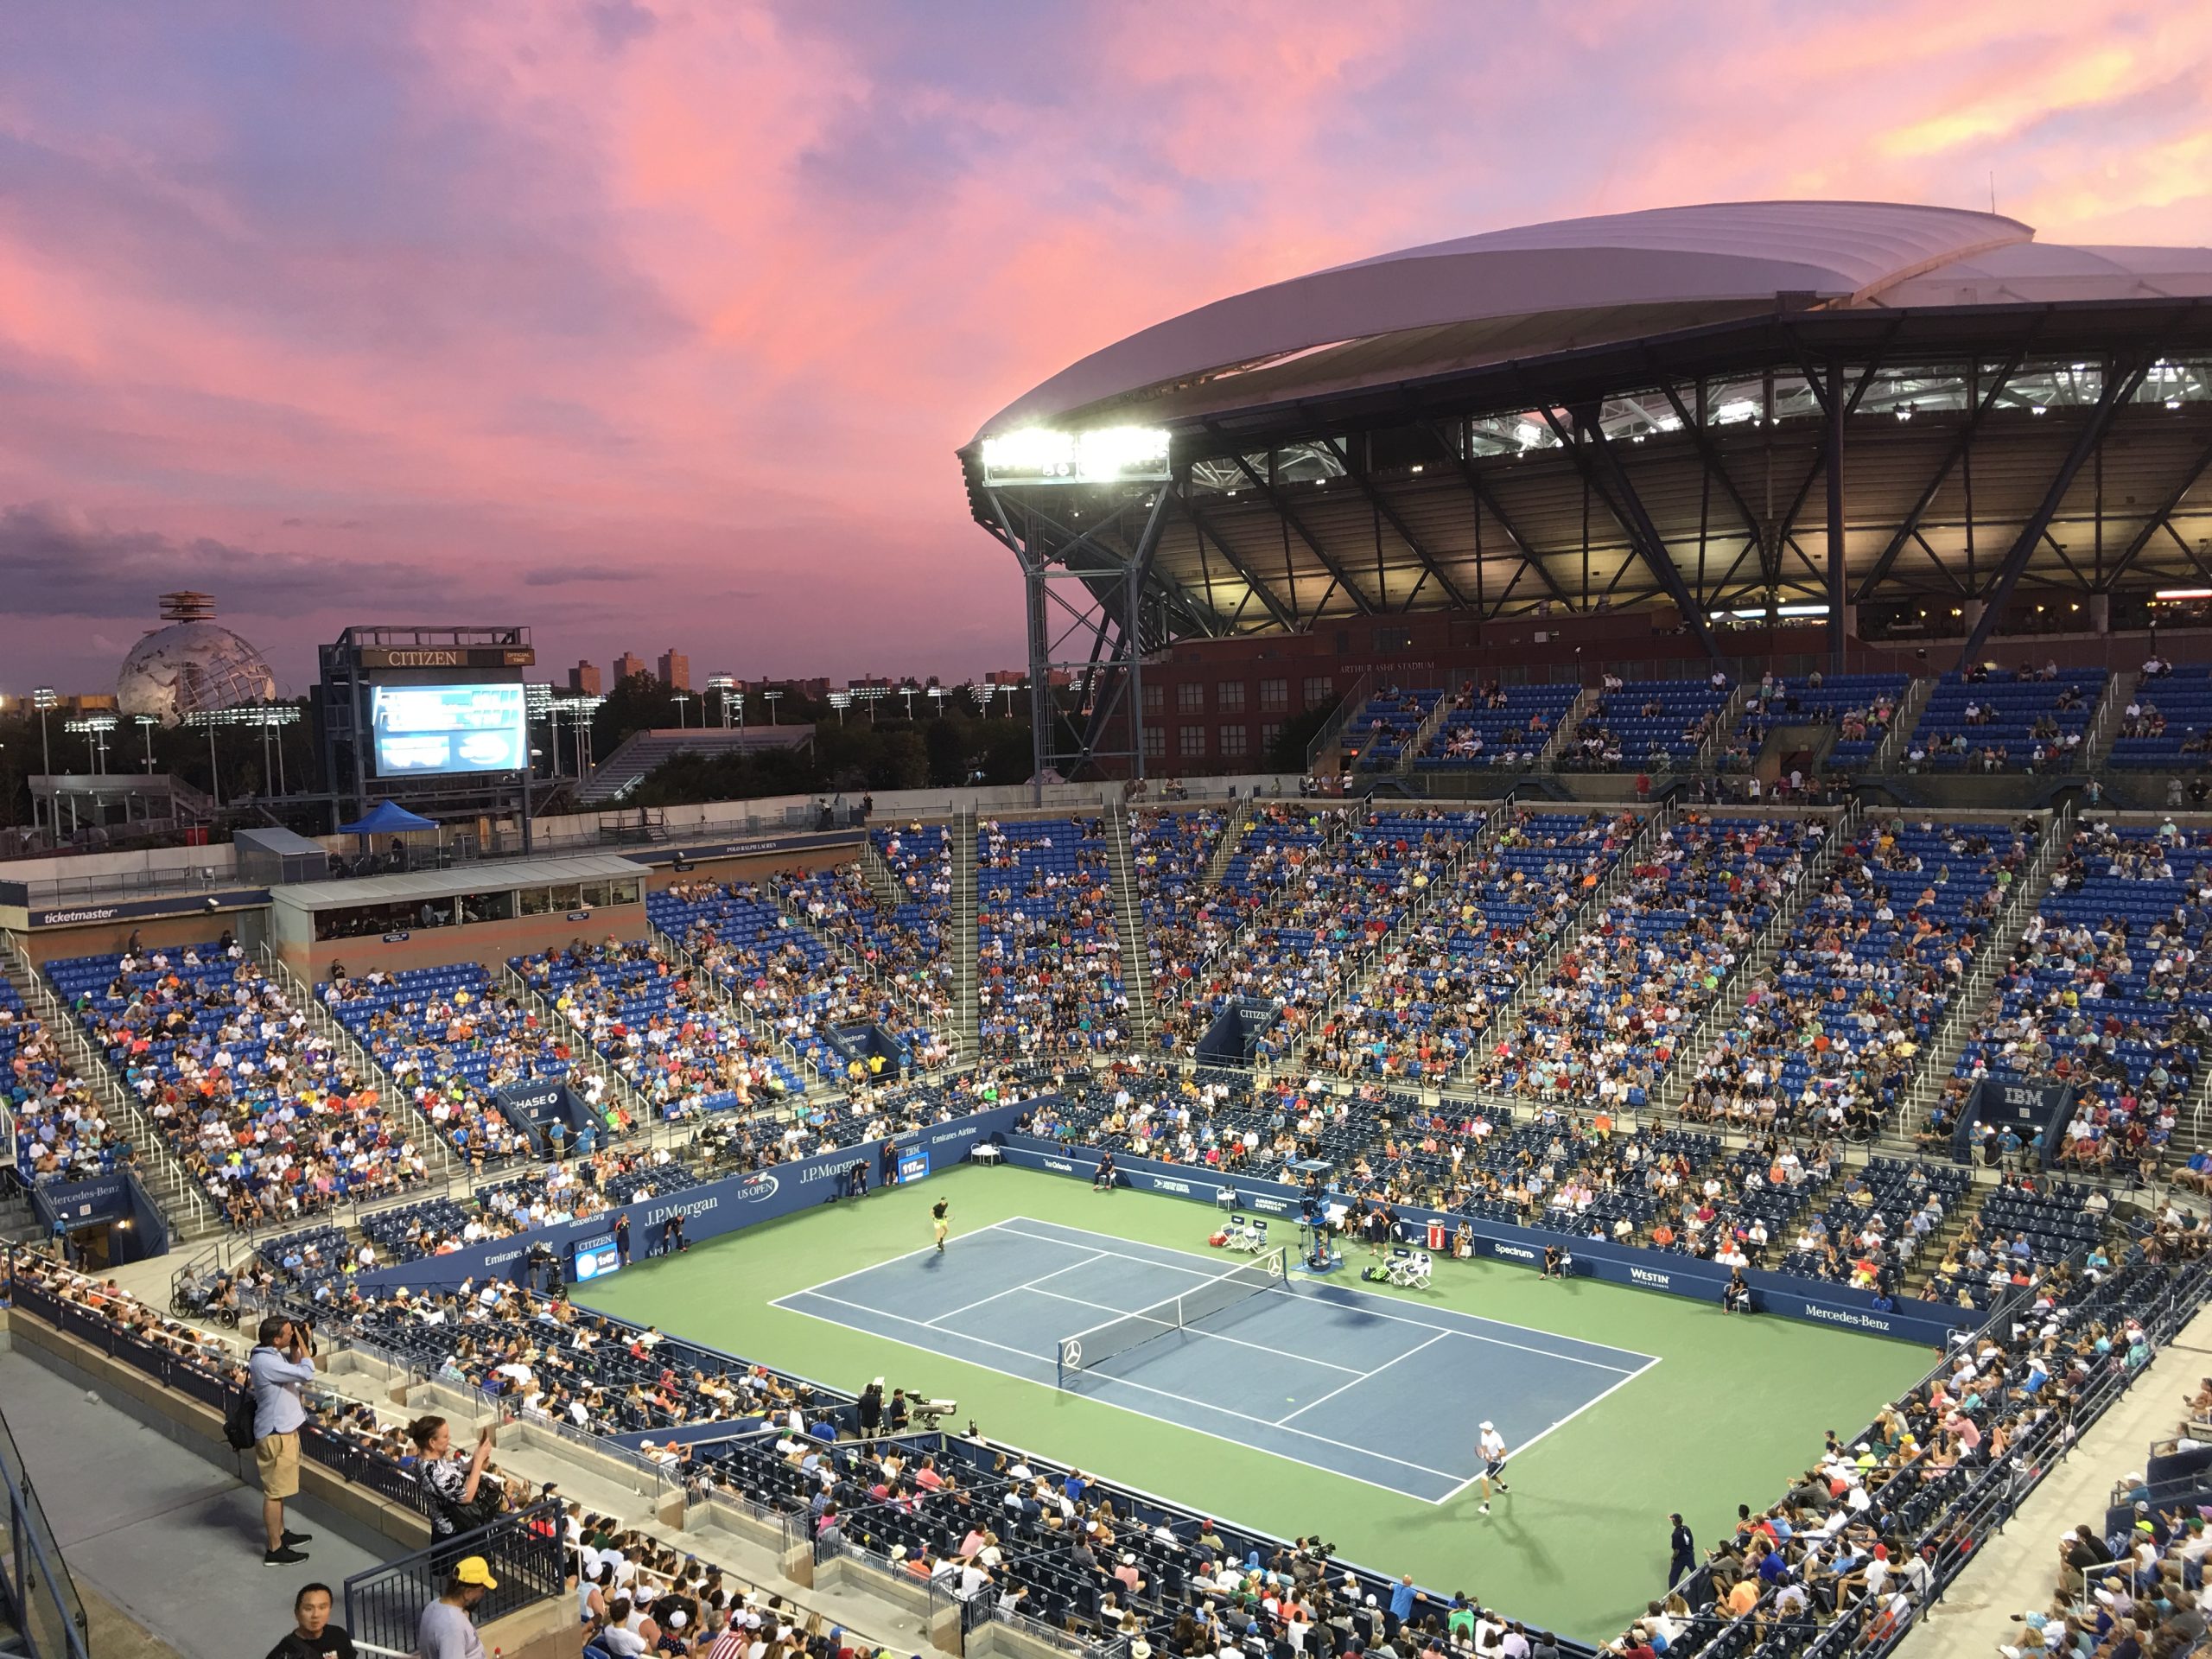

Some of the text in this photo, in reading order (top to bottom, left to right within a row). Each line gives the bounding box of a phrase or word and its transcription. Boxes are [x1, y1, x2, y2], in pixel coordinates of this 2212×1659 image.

[389, 652, 457, 666] CITIZEN
[1340, 664, 1372, 674] ARTHUR
[1397, 662, 1434, 671] STADIUM
[44, 909, 115, 924] ticketmaster
[1240, 1009, 1272, 1020] CITIZEN
[2005, 1087, 2044, 1107] IBM
[931, 1132, 957, 1144] Emirates
[906, 1145, 920, 1157] IBM
[902, 1161, 918, 1174] 117
[737, 1181, 773, 1199] US OPEN
[1255, 1198, 1287, 1208] AMERICAN
[1255, 1202, 1282, 1211] EXPRESS
[645, 1197, 718, 1227] J.P.Morgan
[569, 1213, 605, 1227] usopen.org
[579, 1235, 612, 1251] CITIZEN
[485, 1241, 554, 1266] Emirates Aiine
[1495, 1243, 1531, 1259] Spectrum
[1630, 1267, 1669, 1284] WESTIN
[1805, 1304, 1890, 1331] Mercedes-Benz
